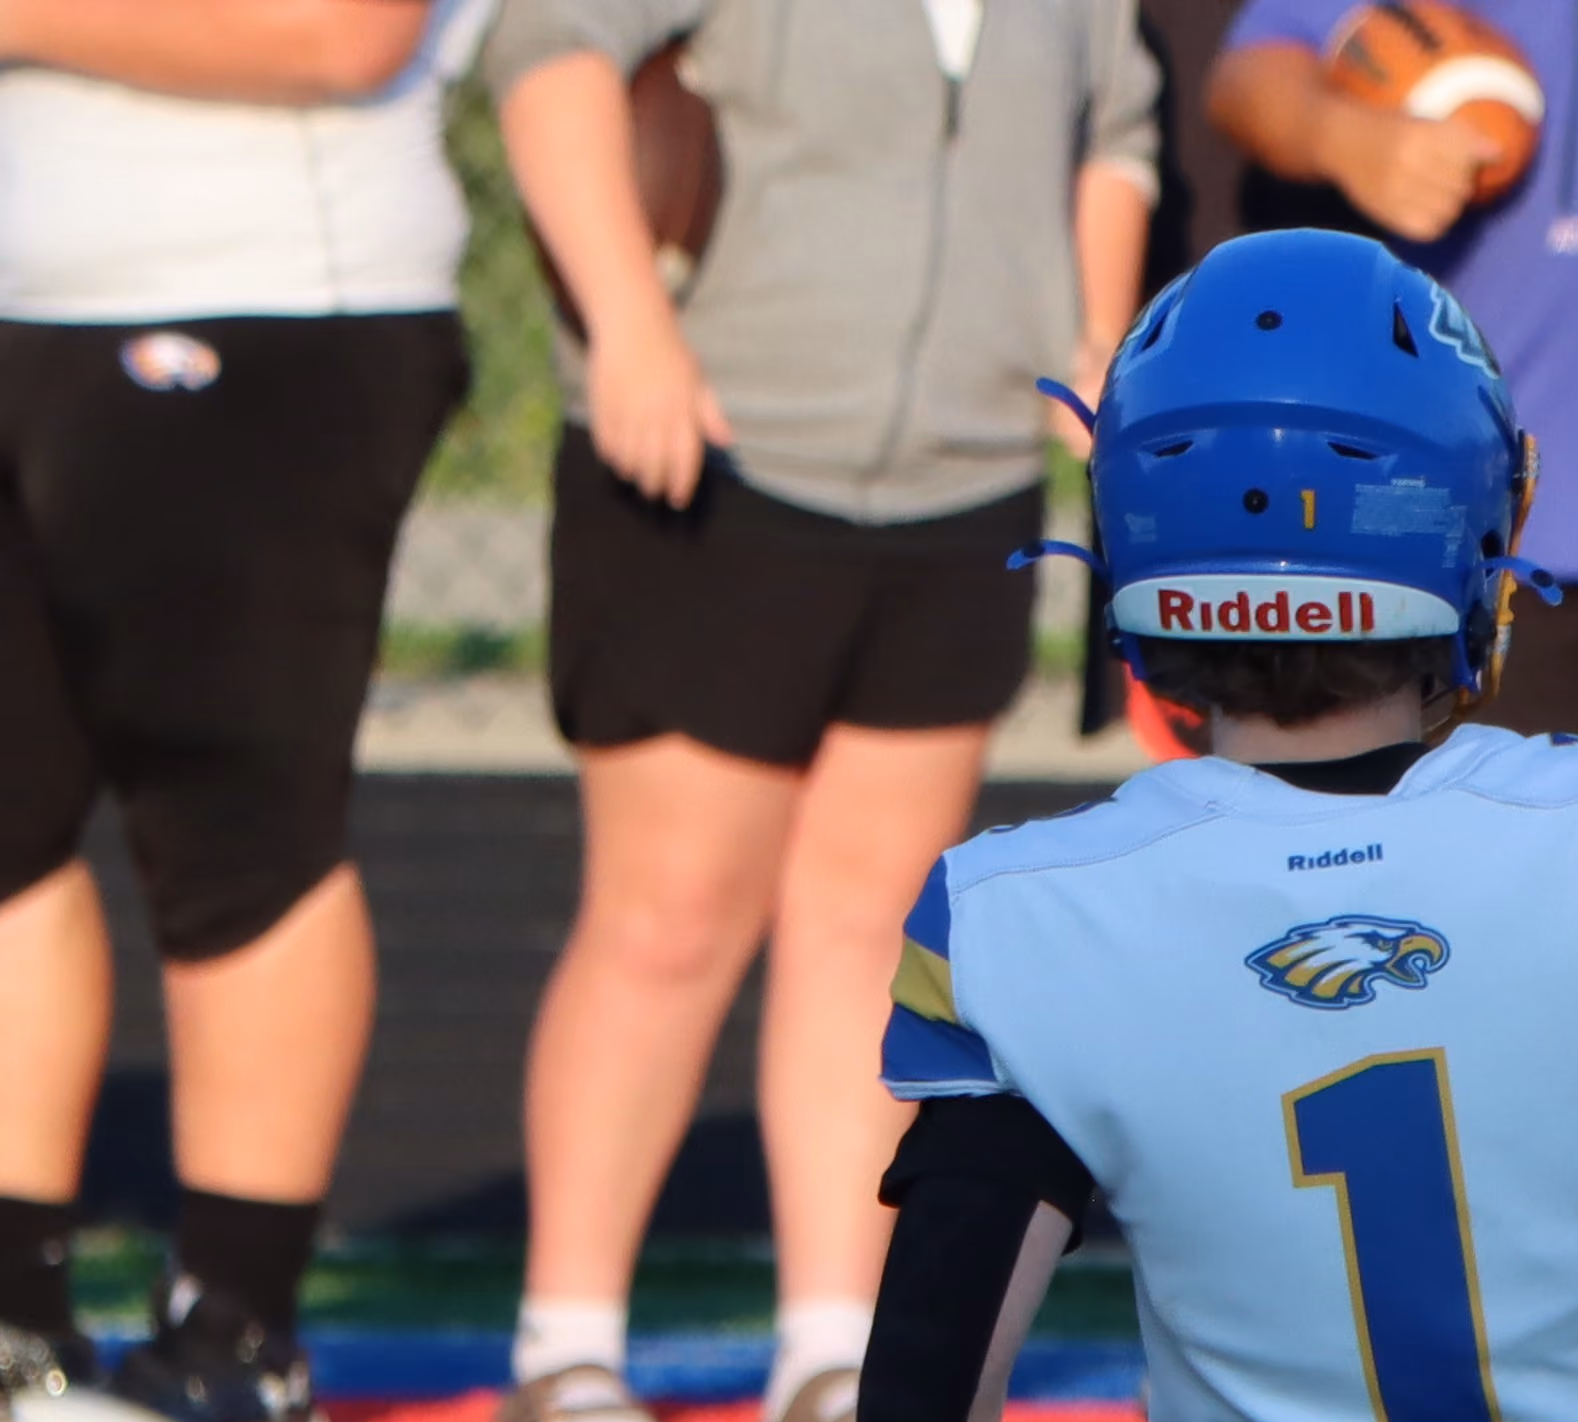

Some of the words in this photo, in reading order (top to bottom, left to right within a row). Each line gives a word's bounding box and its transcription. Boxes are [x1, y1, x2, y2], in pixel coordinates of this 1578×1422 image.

[1300, 489, 1316, 530] 1
[1157, 588, 1375, 633] Riddell
[1286, 842, 1384, 873] Riddell
